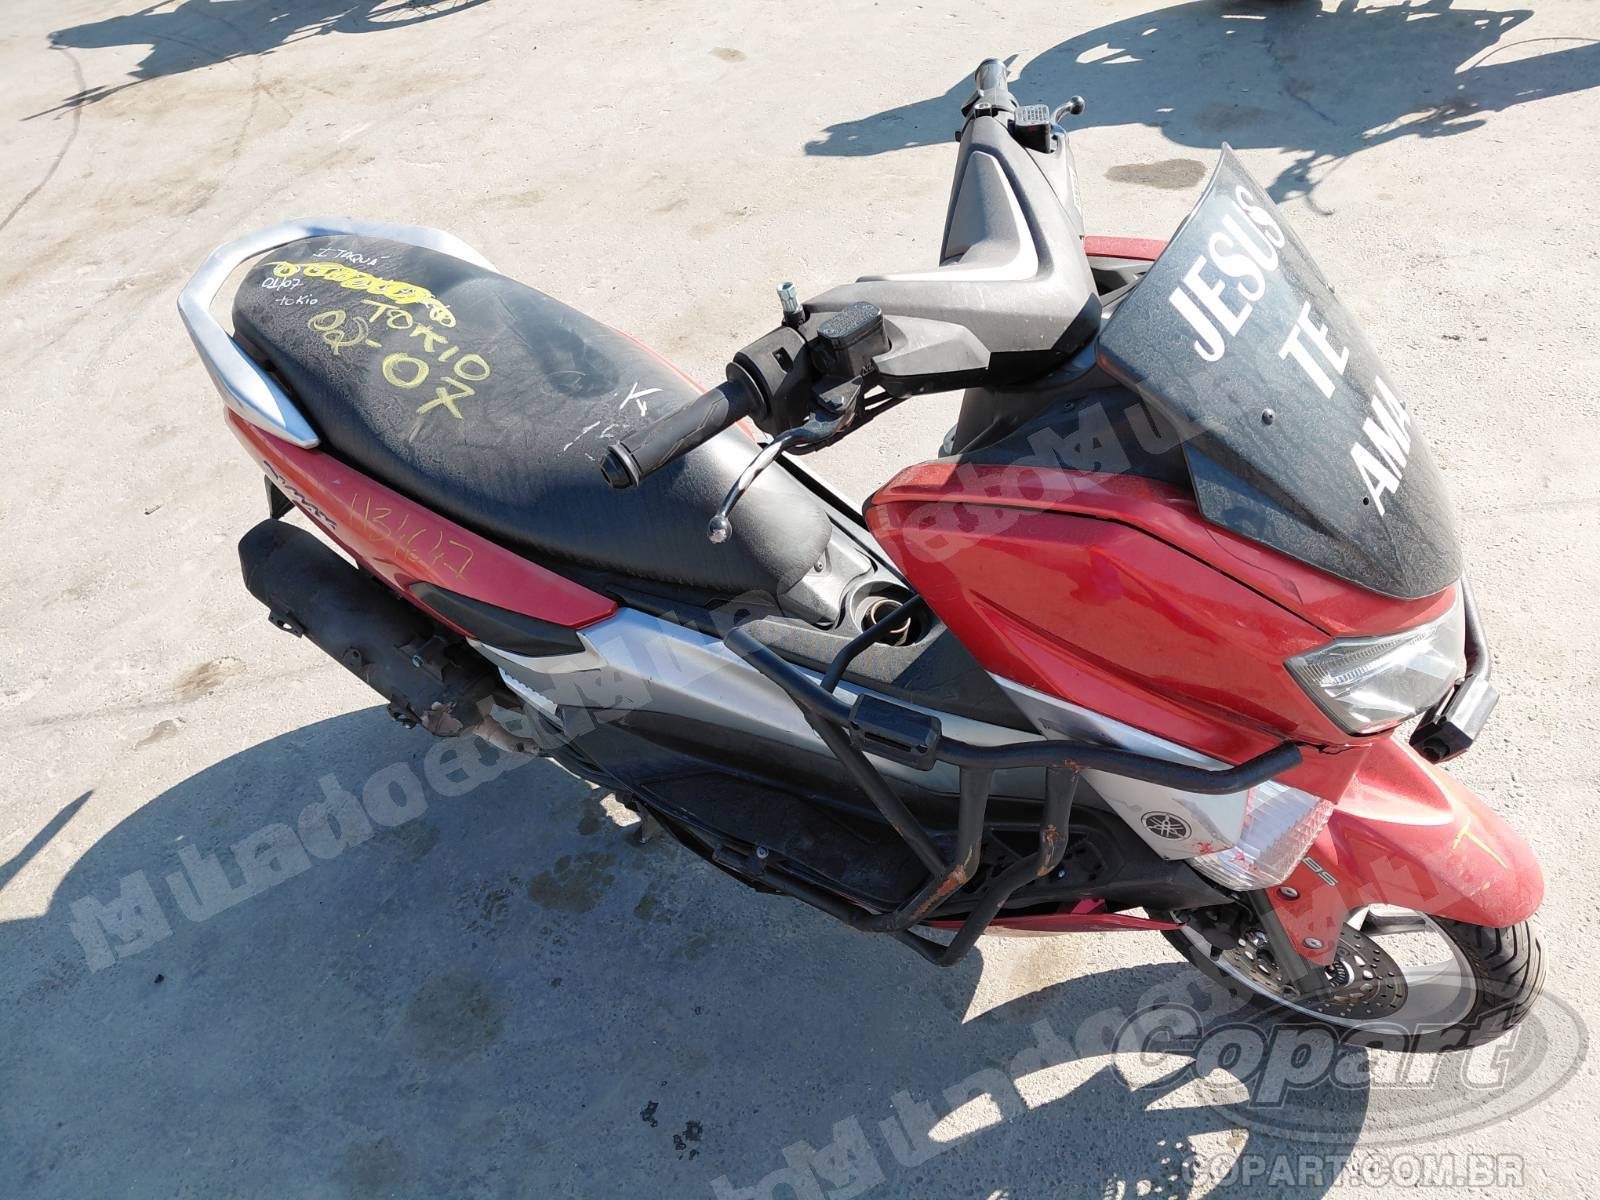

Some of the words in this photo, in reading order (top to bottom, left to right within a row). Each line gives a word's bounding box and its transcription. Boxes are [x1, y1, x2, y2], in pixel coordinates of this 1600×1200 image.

[1168, 185, 1287, 363] JESUS
[360, 298, 491, 382] TOKIO
[1278, 300, 1350, 399] TE
[1302, 856, 1339, 887] BS
